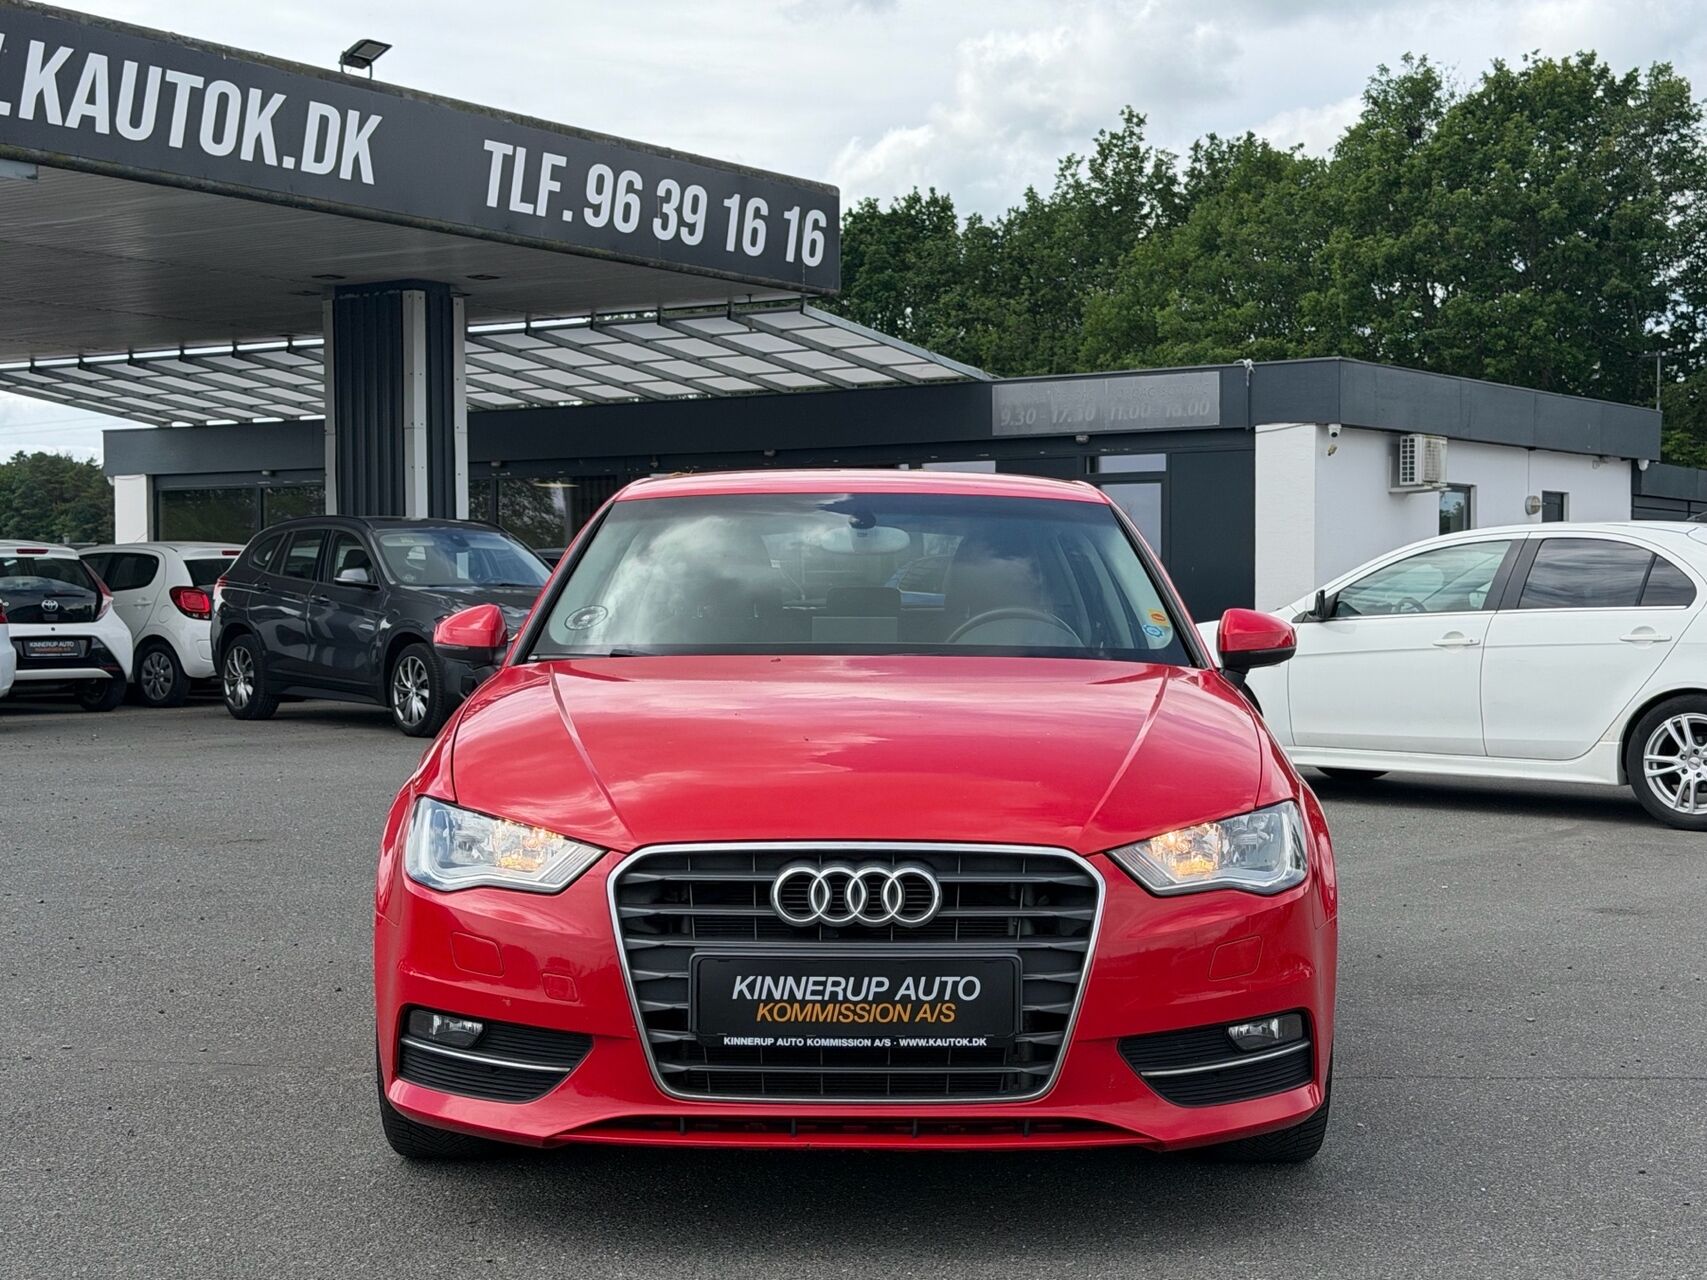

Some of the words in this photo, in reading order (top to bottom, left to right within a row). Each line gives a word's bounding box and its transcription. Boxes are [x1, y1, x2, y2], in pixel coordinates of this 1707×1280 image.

[0, 32, 383, 185] .KAUTOK.DK
[484, 139, 573, 222] TLF.
[583, 164, 643, 234] 96
[653, 178, 708, 246] 39
[723, 193, 769, 257] 16
[783, 205, 827, 267] 16
[732, 975, 889, 1001] KINNERUP
[895, 975, 981, 1001] AUTO
[756, 1002, 911, 1023] KOMMISSION
[914, 1002, 957, 1023] A/S
[723, 1036, 775, 1046] KINNERUP
[776, 1037, 805, 1047] AUTO
[806, 1037, 871, 1047] KOMMISSION
[872, 1037, 891, 1047] A/S
[898, 1037, 988, 1047] WWW.KAUTOK.DK
